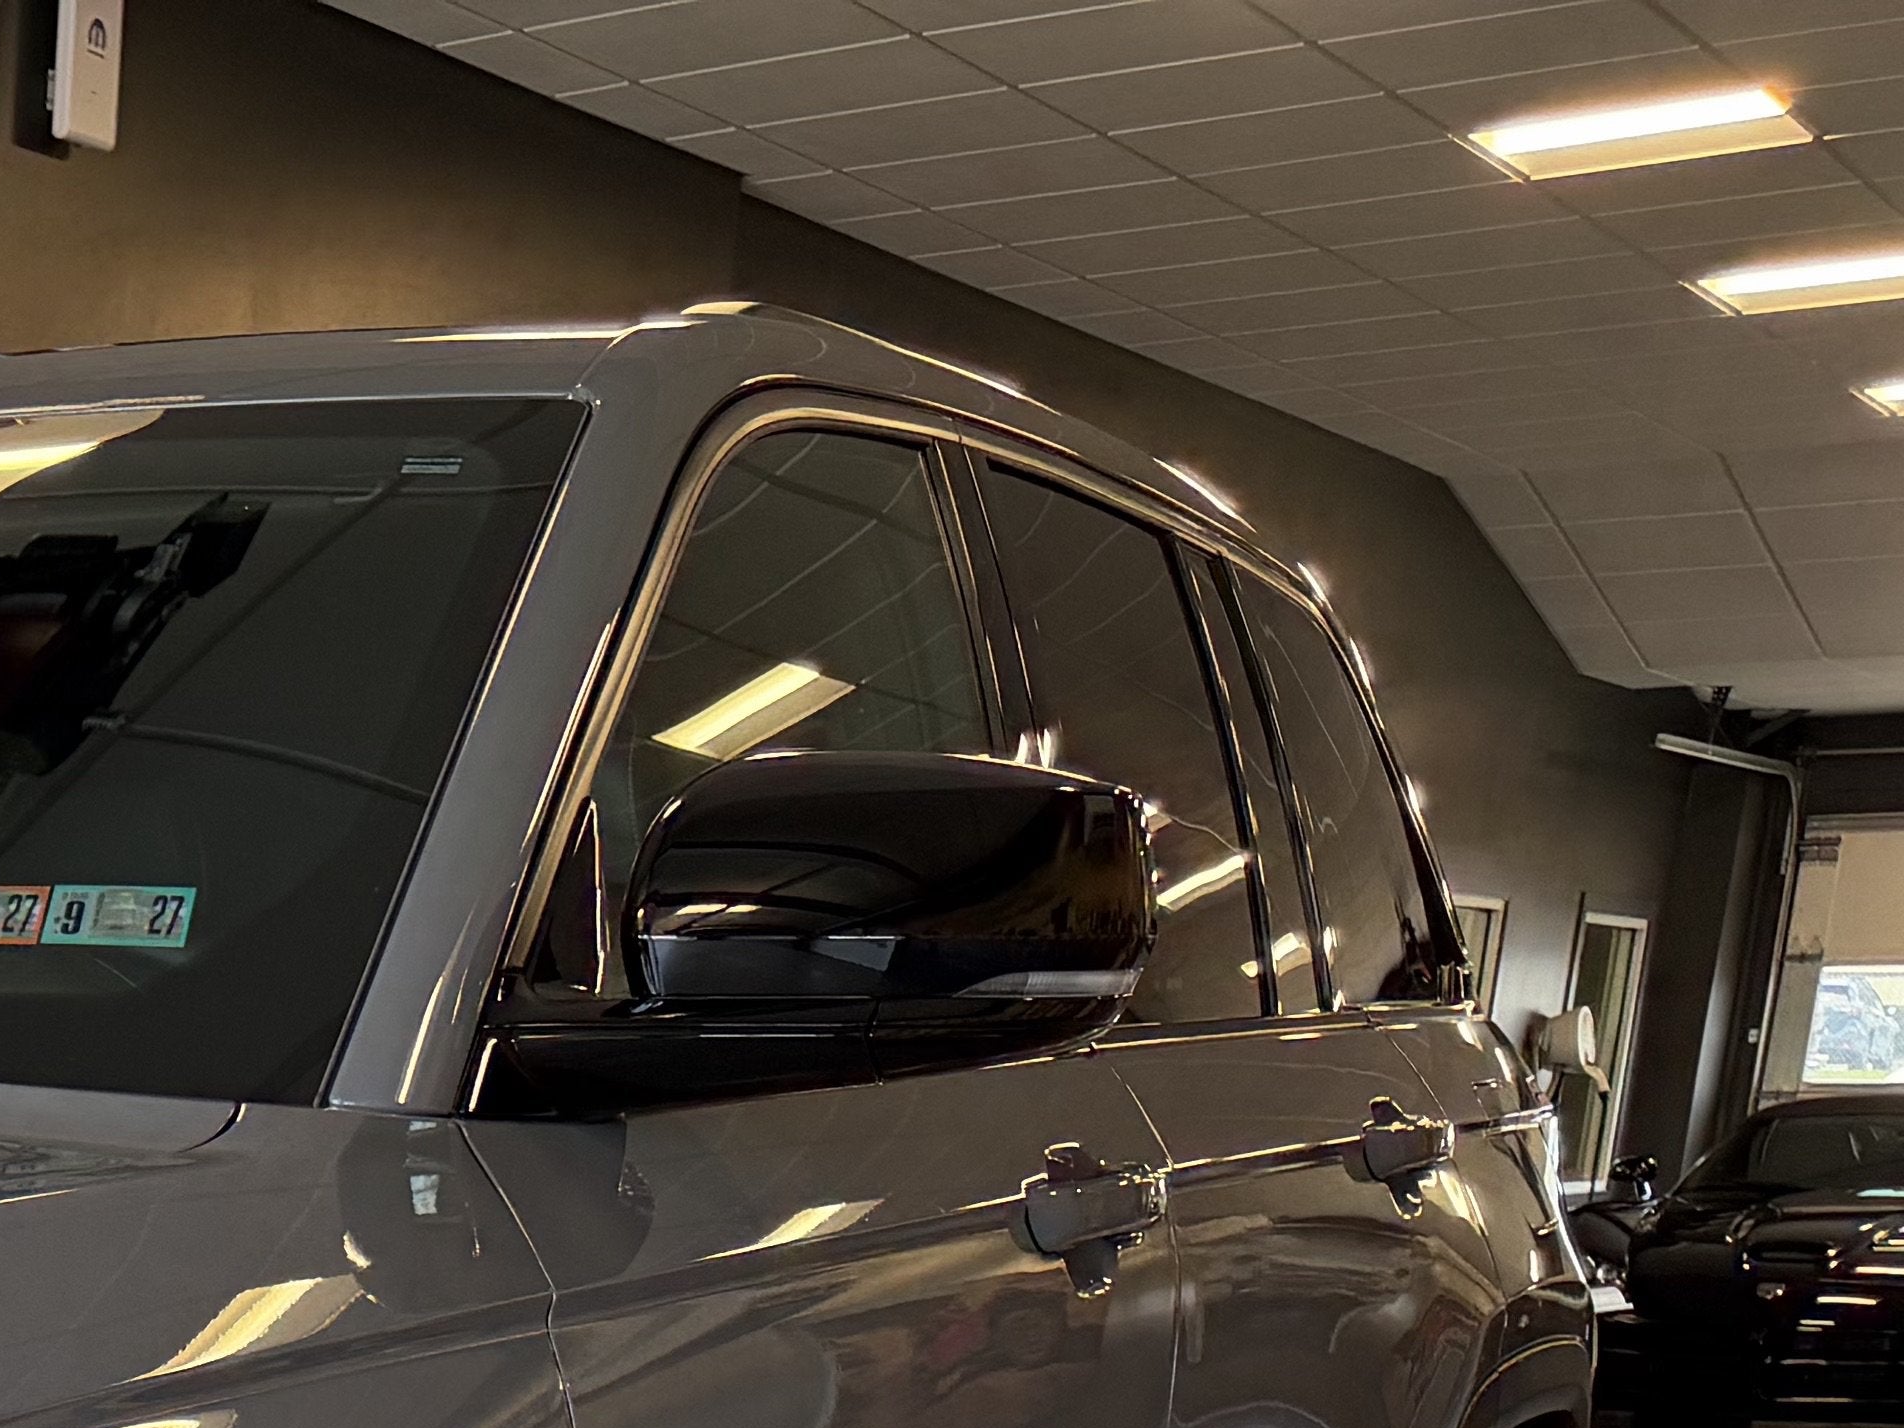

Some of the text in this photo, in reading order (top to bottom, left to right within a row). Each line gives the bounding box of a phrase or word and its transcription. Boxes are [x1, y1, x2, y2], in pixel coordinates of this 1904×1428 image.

[2, 894, 39, 937] 27
[60, 895, 185, 935] 9 27
